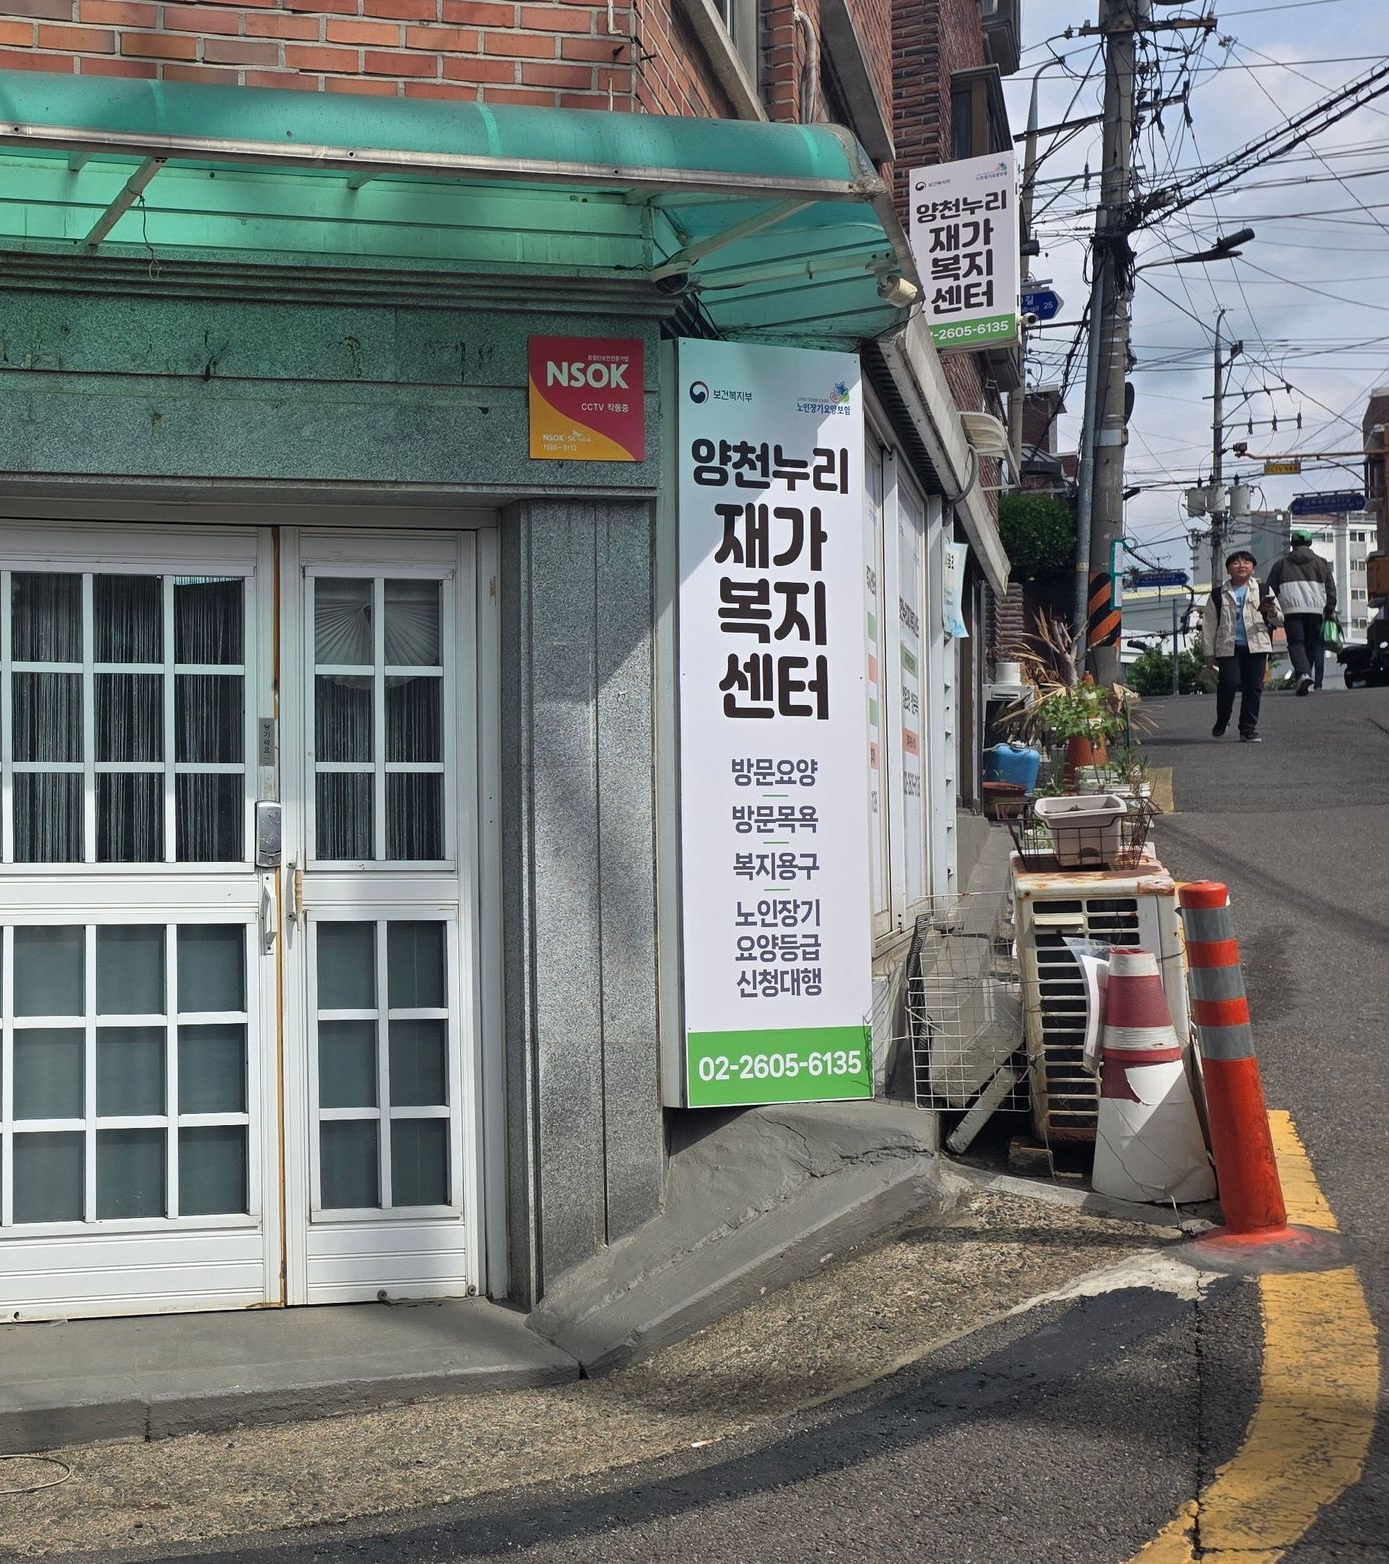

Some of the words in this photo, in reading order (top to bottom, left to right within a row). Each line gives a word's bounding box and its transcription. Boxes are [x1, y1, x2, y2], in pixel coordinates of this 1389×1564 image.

[916, 189, 1007, 224] 양천누리
[929, 217, 994, 254] 재가
[931, 249, 994, 282] 복지
[931, 279, 994, 315] 센터
[1043, 301, 1054, 310] 25
[930, 320, 1009, 340] -2605-6135
[546, 360, 629, 389] NSOK
[581, 402, 604, 412] CCTV
[607, 403, 629, 413] 작동중
[713, 389, 753, 402] 보건복지부
[796, 402, 851, 416] 노인장기요양보험
[691, 438, 849, 495] 양천누리
[714, 502, 828, 572] 재가
[717, 576, 828, 646] 복지
[719, 653, 829, 720] 센터
[263, 723, 271, 754] 당기세요
[731, 757, 819, 787] 방문요양
[732, 805, 819, 834] 방문목욕
[732, 852, 820, 881] 복지용구
[735, 898, 821, 928] 노인장기
[734, 933, 822, 962] 요양등급
[736, 966, 823, 998] 신청대행
[698, 1049, 862, 1082] 02-2605-6135
